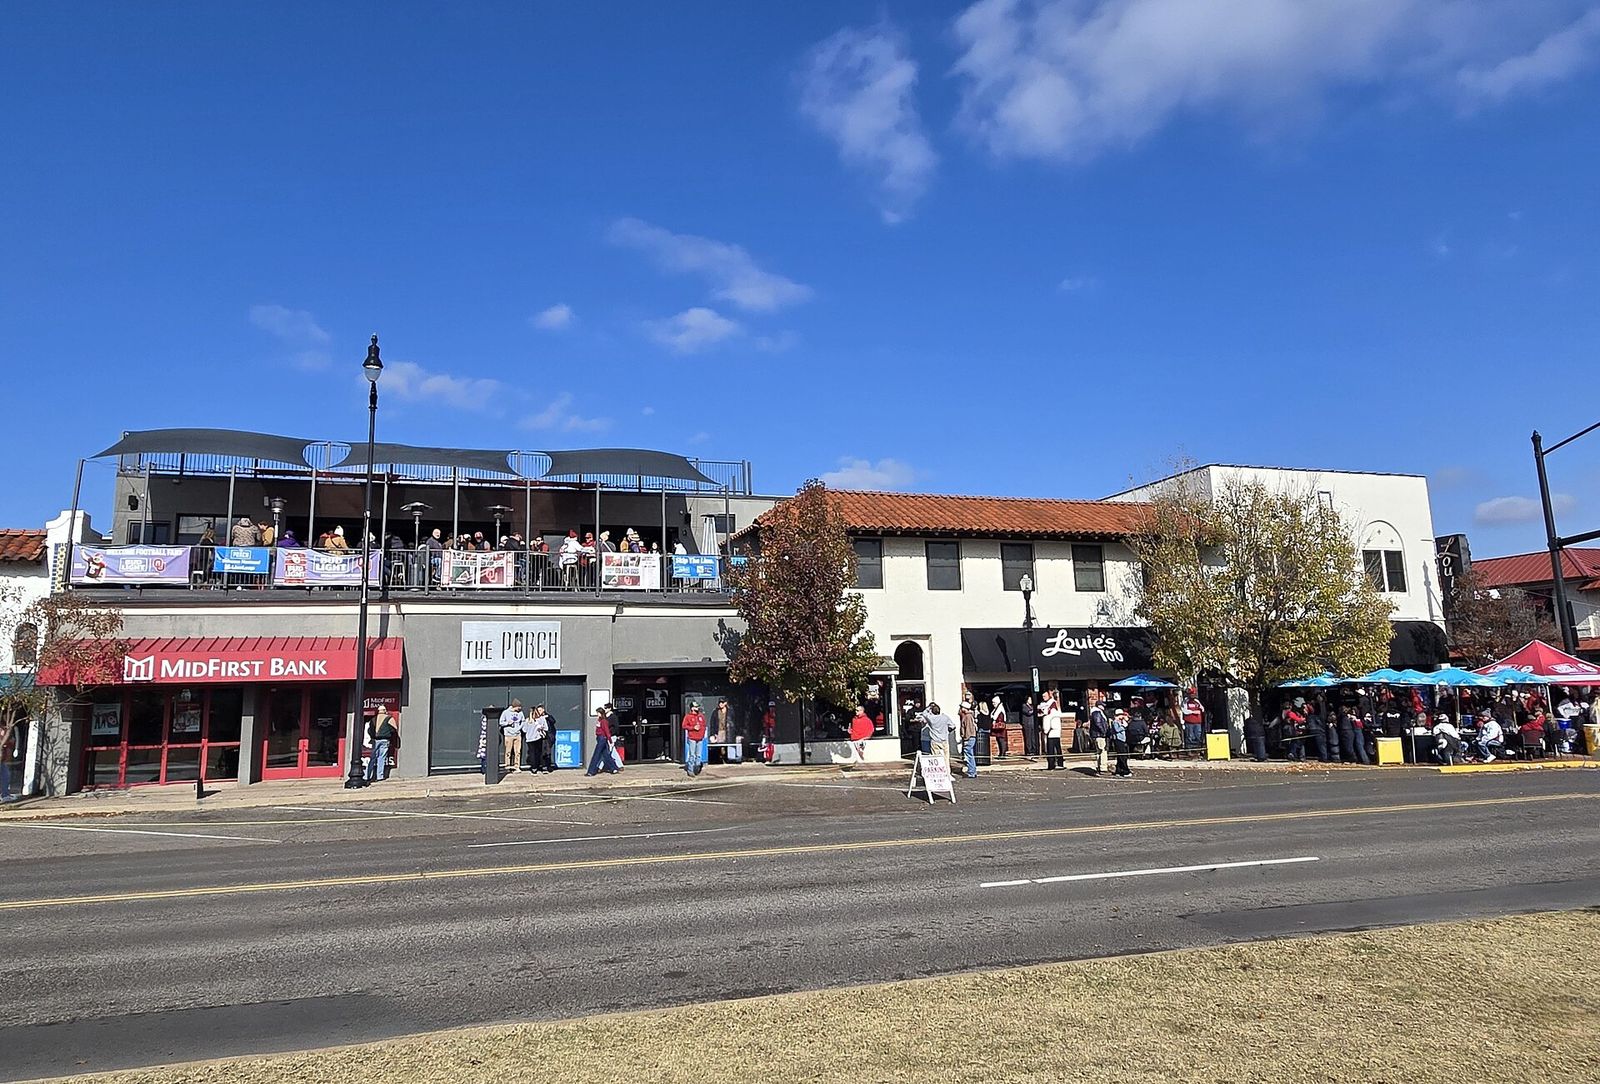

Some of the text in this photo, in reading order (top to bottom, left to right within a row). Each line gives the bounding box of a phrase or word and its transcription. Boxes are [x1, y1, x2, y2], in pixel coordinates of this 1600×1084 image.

[319, 556, 344, 564] BUD
[315, 563, 347, 571] LIGHT
[465, 631, 558, 660] THE PORCH
[1041, 629, 1116, 657] Louie's
[1097, 649, 1124, 662] TOO
